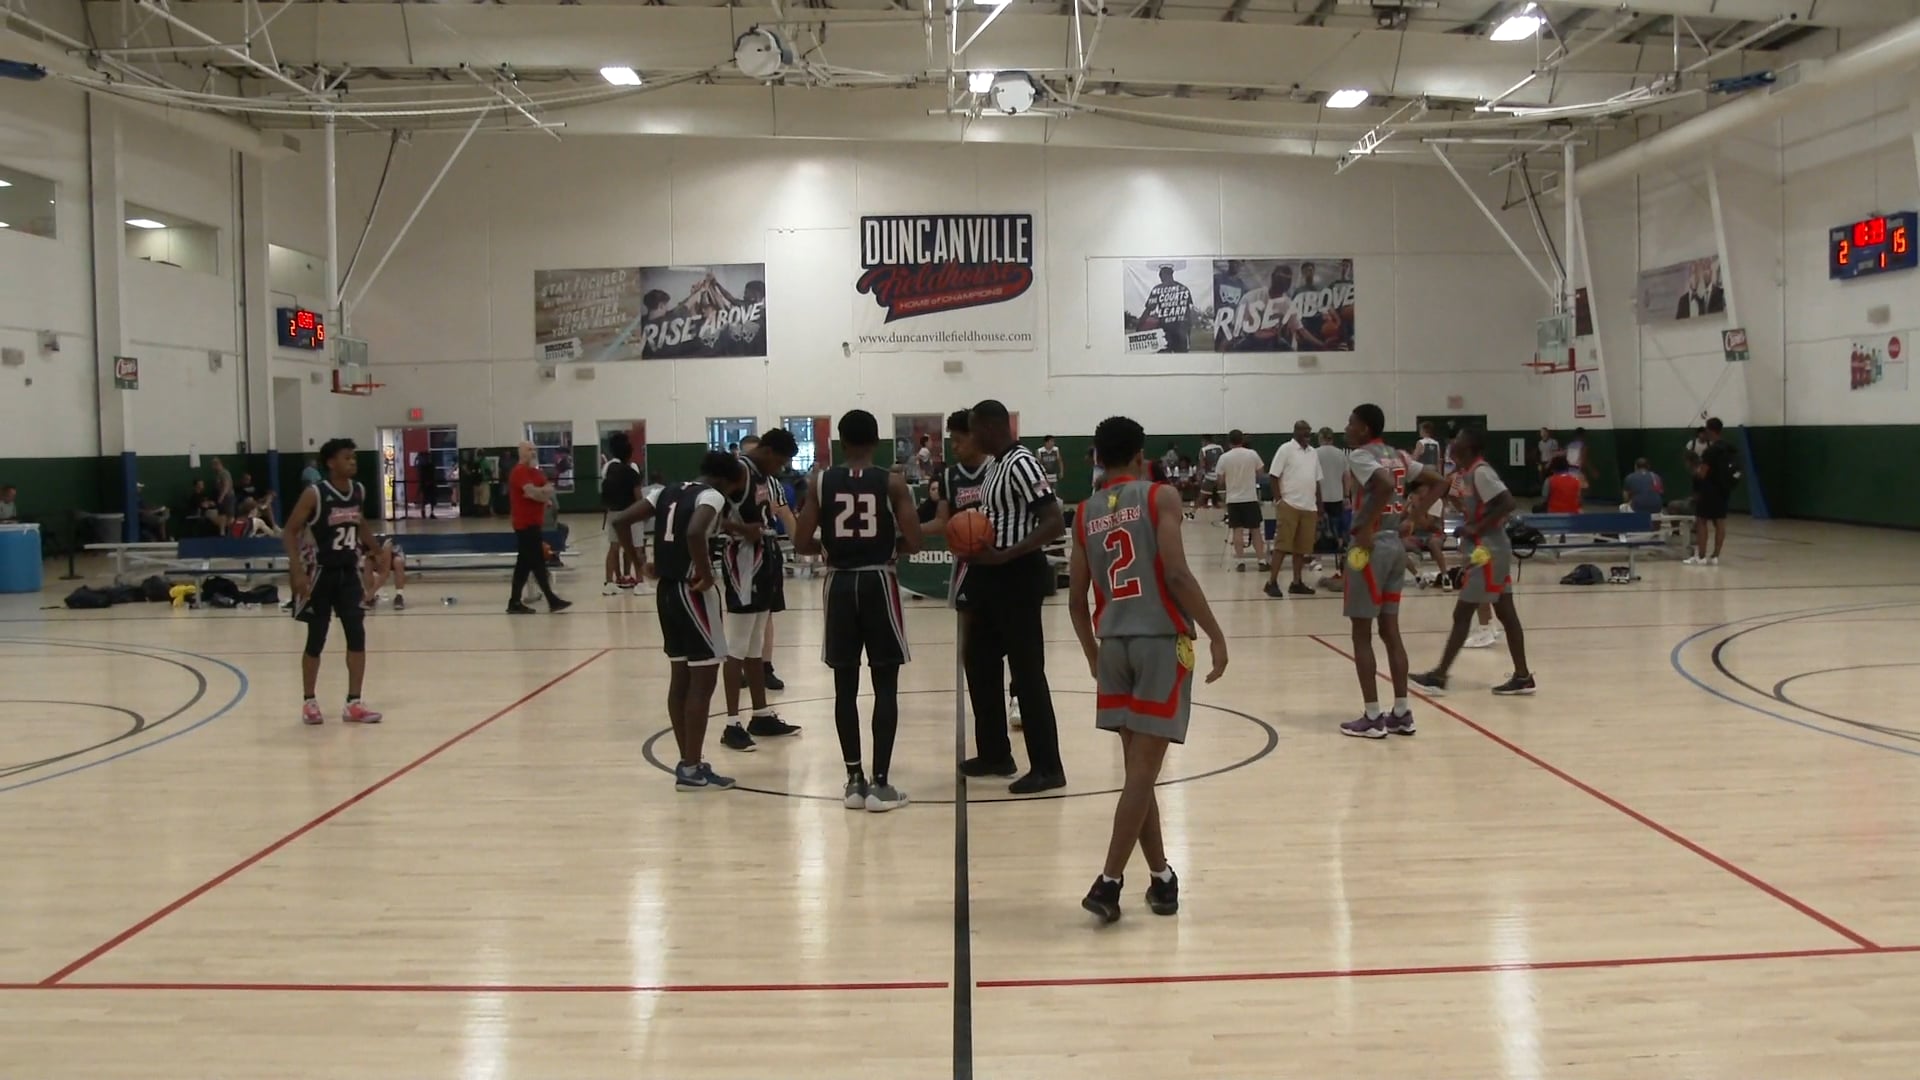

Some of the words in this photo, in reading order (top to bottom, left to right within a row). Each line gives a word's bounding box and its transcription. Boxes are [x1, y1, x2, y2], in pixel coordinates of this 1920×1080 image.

[865, 218, 1029, 265] DUNCANVILLE
[1838, 240, 1849, 264] 2
[574, 269, 627, 292] FOCUSED
[862, 257, 1013, 303] Fieldhouse
[899, 299, 930, 310] HOME
[931, 297, 941, 306] of
[942, 288, 1004, 305] CHAMPIONS
[1158, 290, 1190, 302] COURTS
[558, 302, 619, 326] TOGETHER
[1158, 306, 1188, 318] LEARN
[1213, 300, 1280, 341] RISE
[1282, 283, 1354, 325] ABOVE
[290, 319, 296, 336] 2
[643, 315, 702, 351] RISE
[699, 301, 764, 338] ABOVE
[858, 331, 1033, 344] www.duncanvillefieldhouse.com
[663, 501, 678, 542] 1
[834, 492, 878, 538] 23
[1087, 504, 1141, 535] HUSKERS
[332, 526, 356, 551] 24
[908, 550, 954, 565] BRIDG
[1102, 527, 1142, 602] 2
